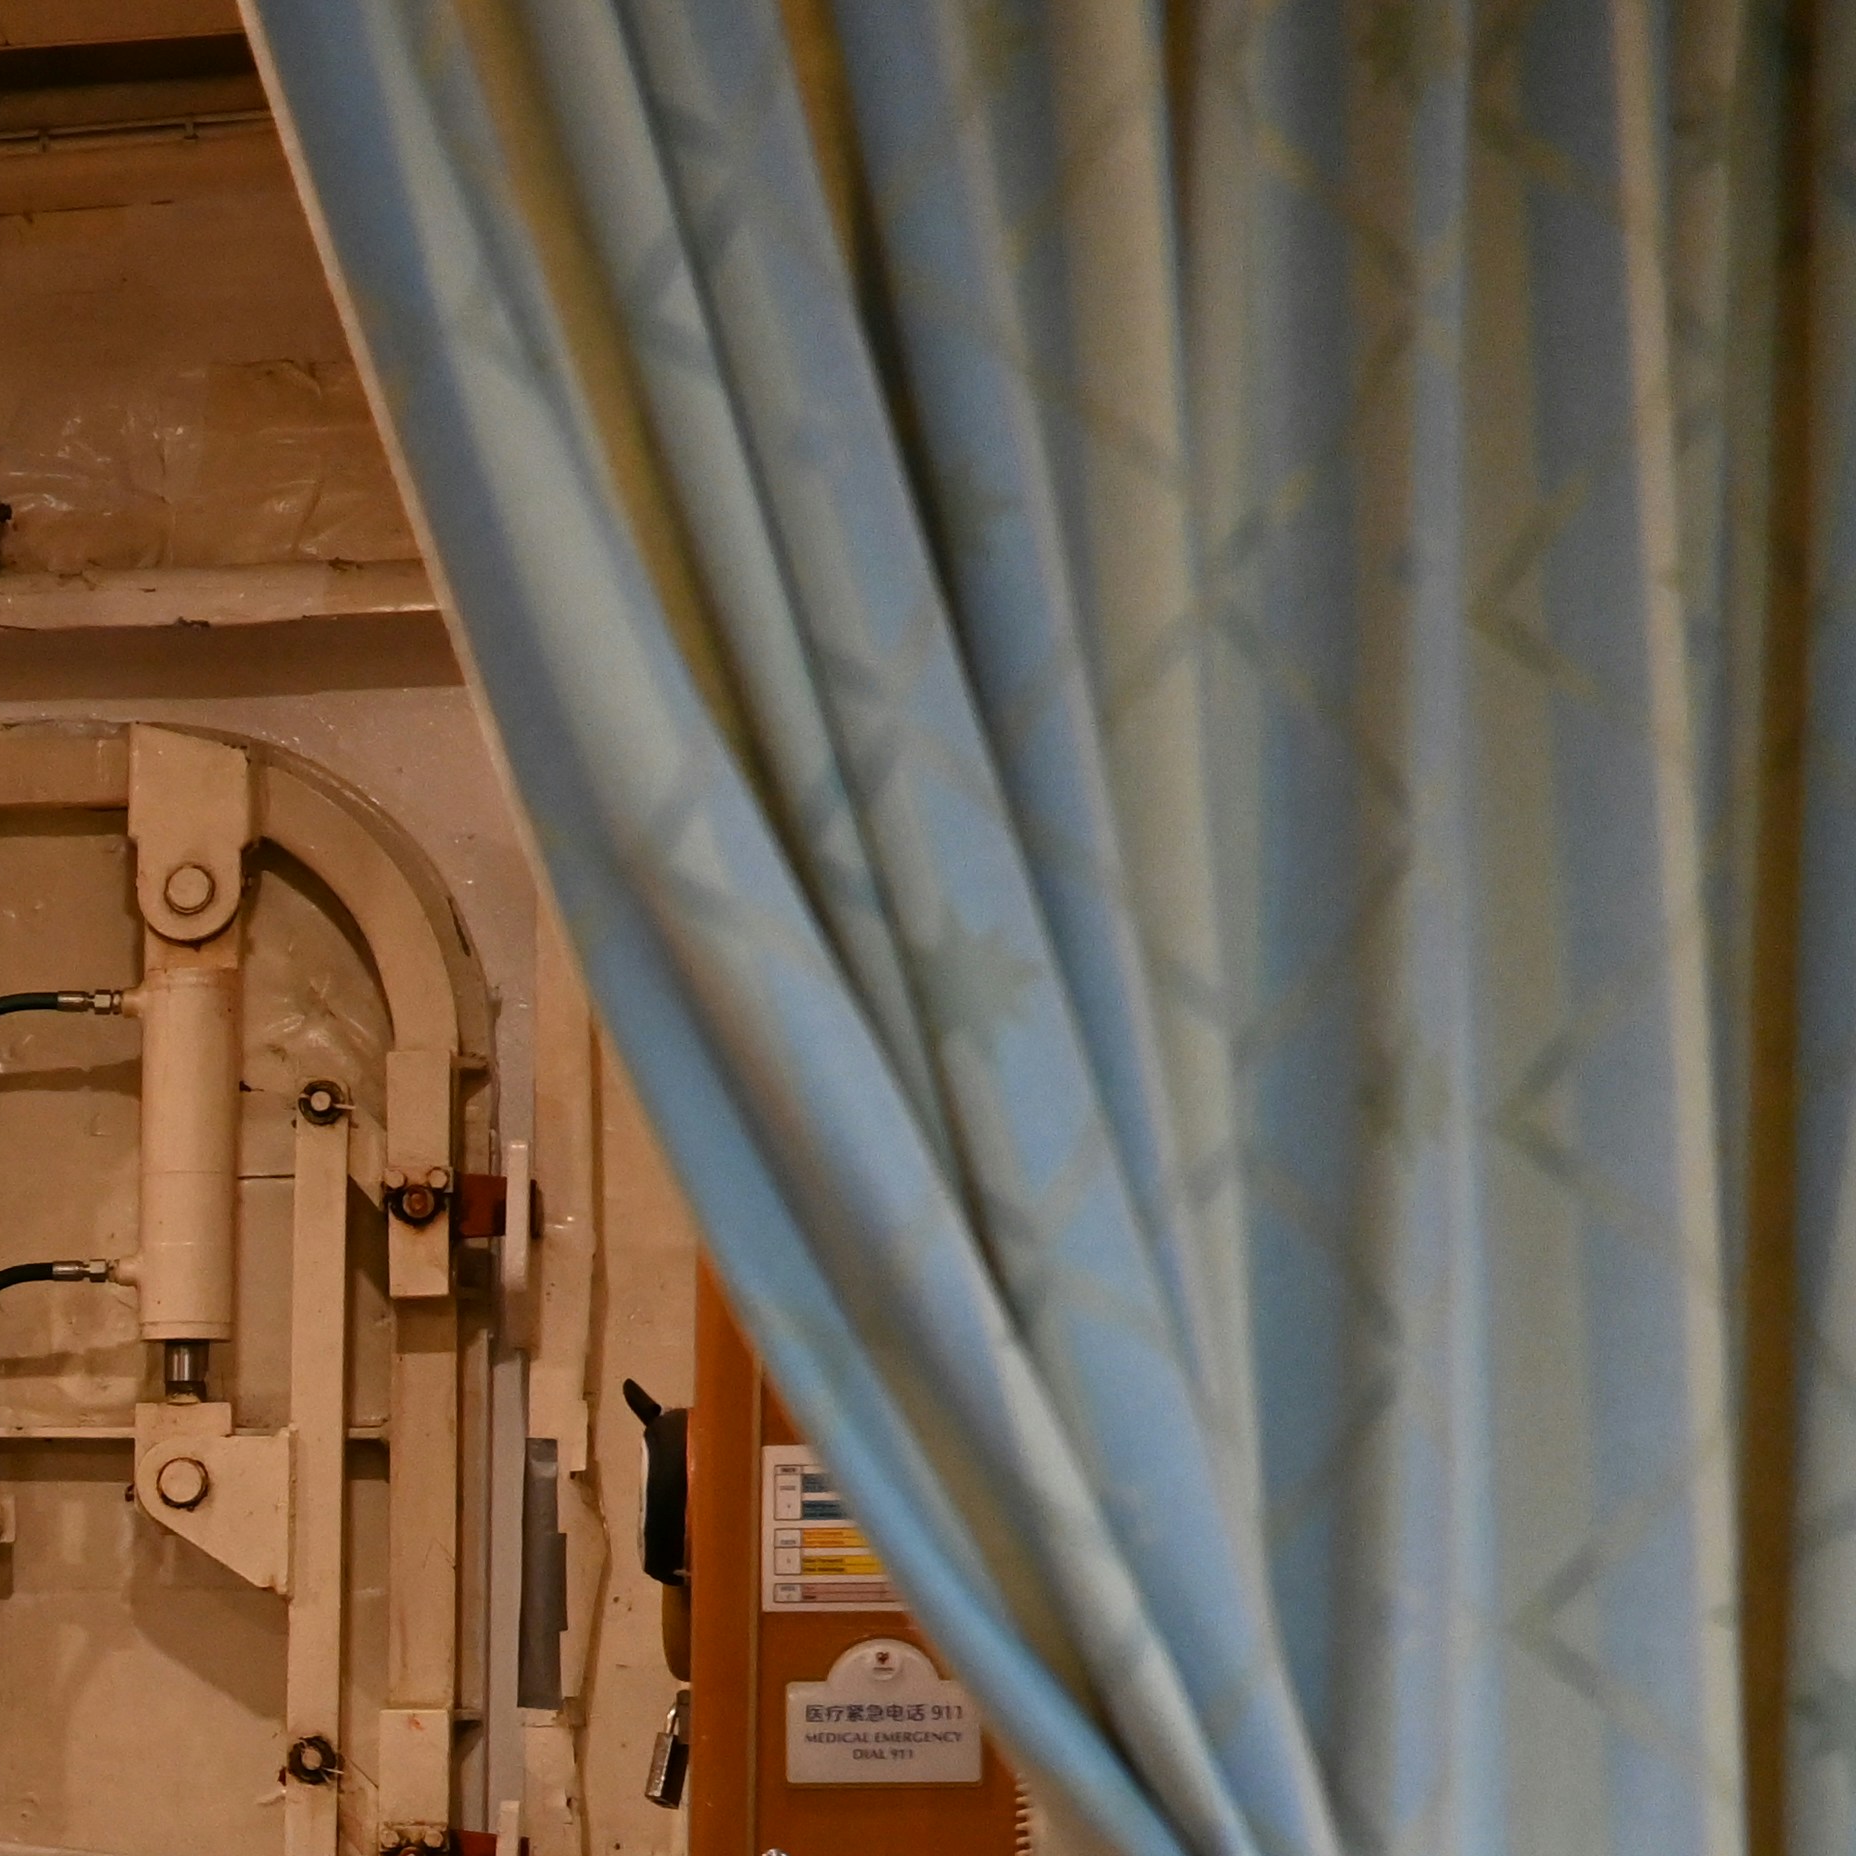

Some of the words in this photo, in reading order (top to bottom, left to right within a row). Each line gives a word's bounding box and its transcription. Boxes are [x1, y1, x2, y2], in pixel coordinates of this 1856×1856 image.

[805, 1703, 926, 1722] 医疗紧急电话
[931, 1704, 963, 1721] 911
[805, 1731, 869, 1744] MEDICAL
[874, 1731, 962, 1744] EMERGENCY
[852, 1749, 887, 1760] DIAL
[891, 1748, 914, 1760] 911
